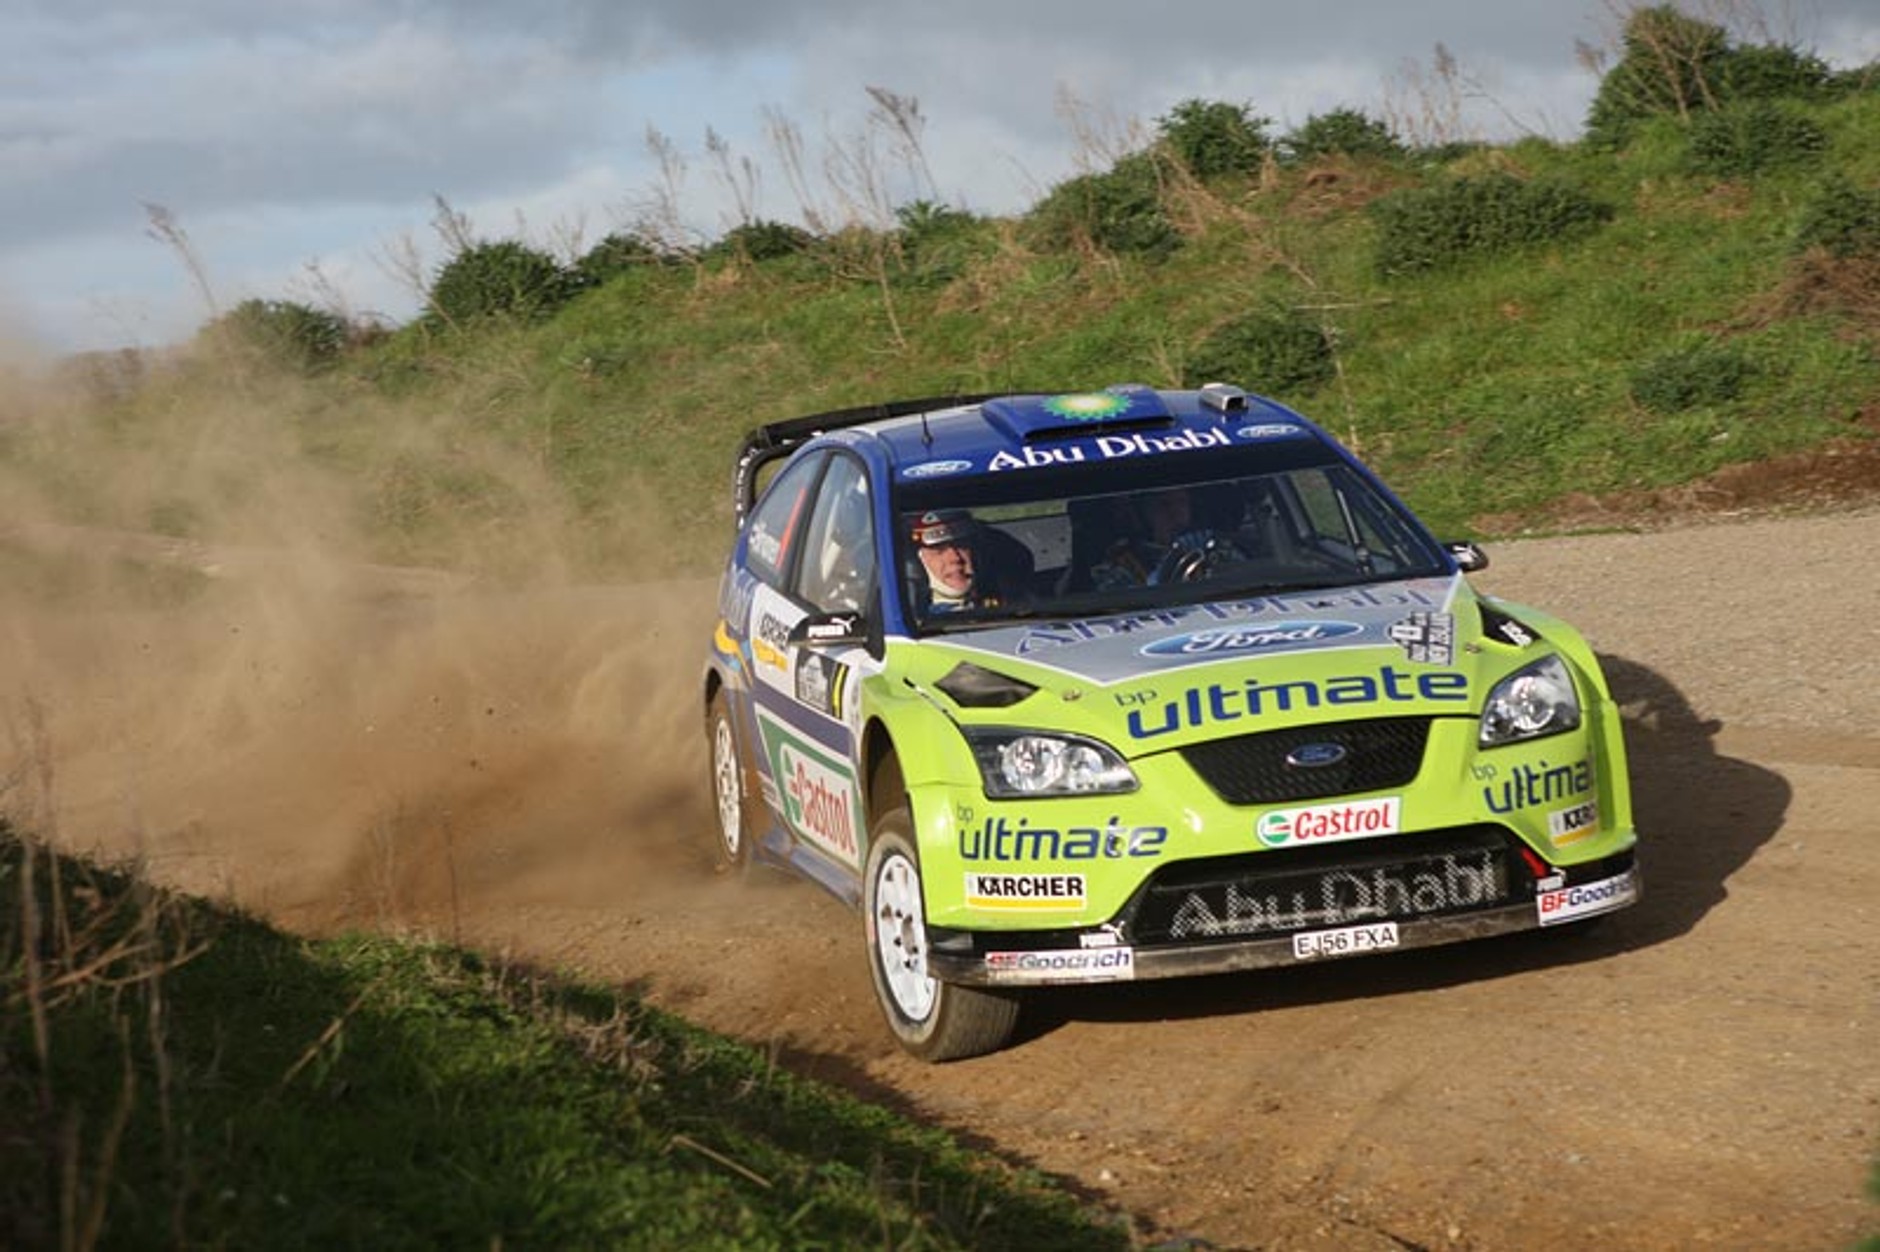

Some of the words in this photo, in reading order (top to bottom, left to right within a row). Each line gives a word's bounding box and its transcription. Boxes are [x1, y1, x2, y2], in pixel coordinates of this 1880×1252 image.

[988, 441, 1084, 472] Abu
[1182, 624, 1327, 653] Ford
[1115, 688, 1157, 707] bp
[1127, 666, 1468, 740] ultimate
[796, 761, 856, 854] Castrol
[1294, 803, 1391, 840] Castrol
[959, 816, 1168, 861] ultimate
[1169, 884, 1307, 938] Abu
[1321, 849, 1497, 925] Dhabi
[1296, 934, 1349, 957] EJ56
[1352, 926, 1397, 949] FXA
